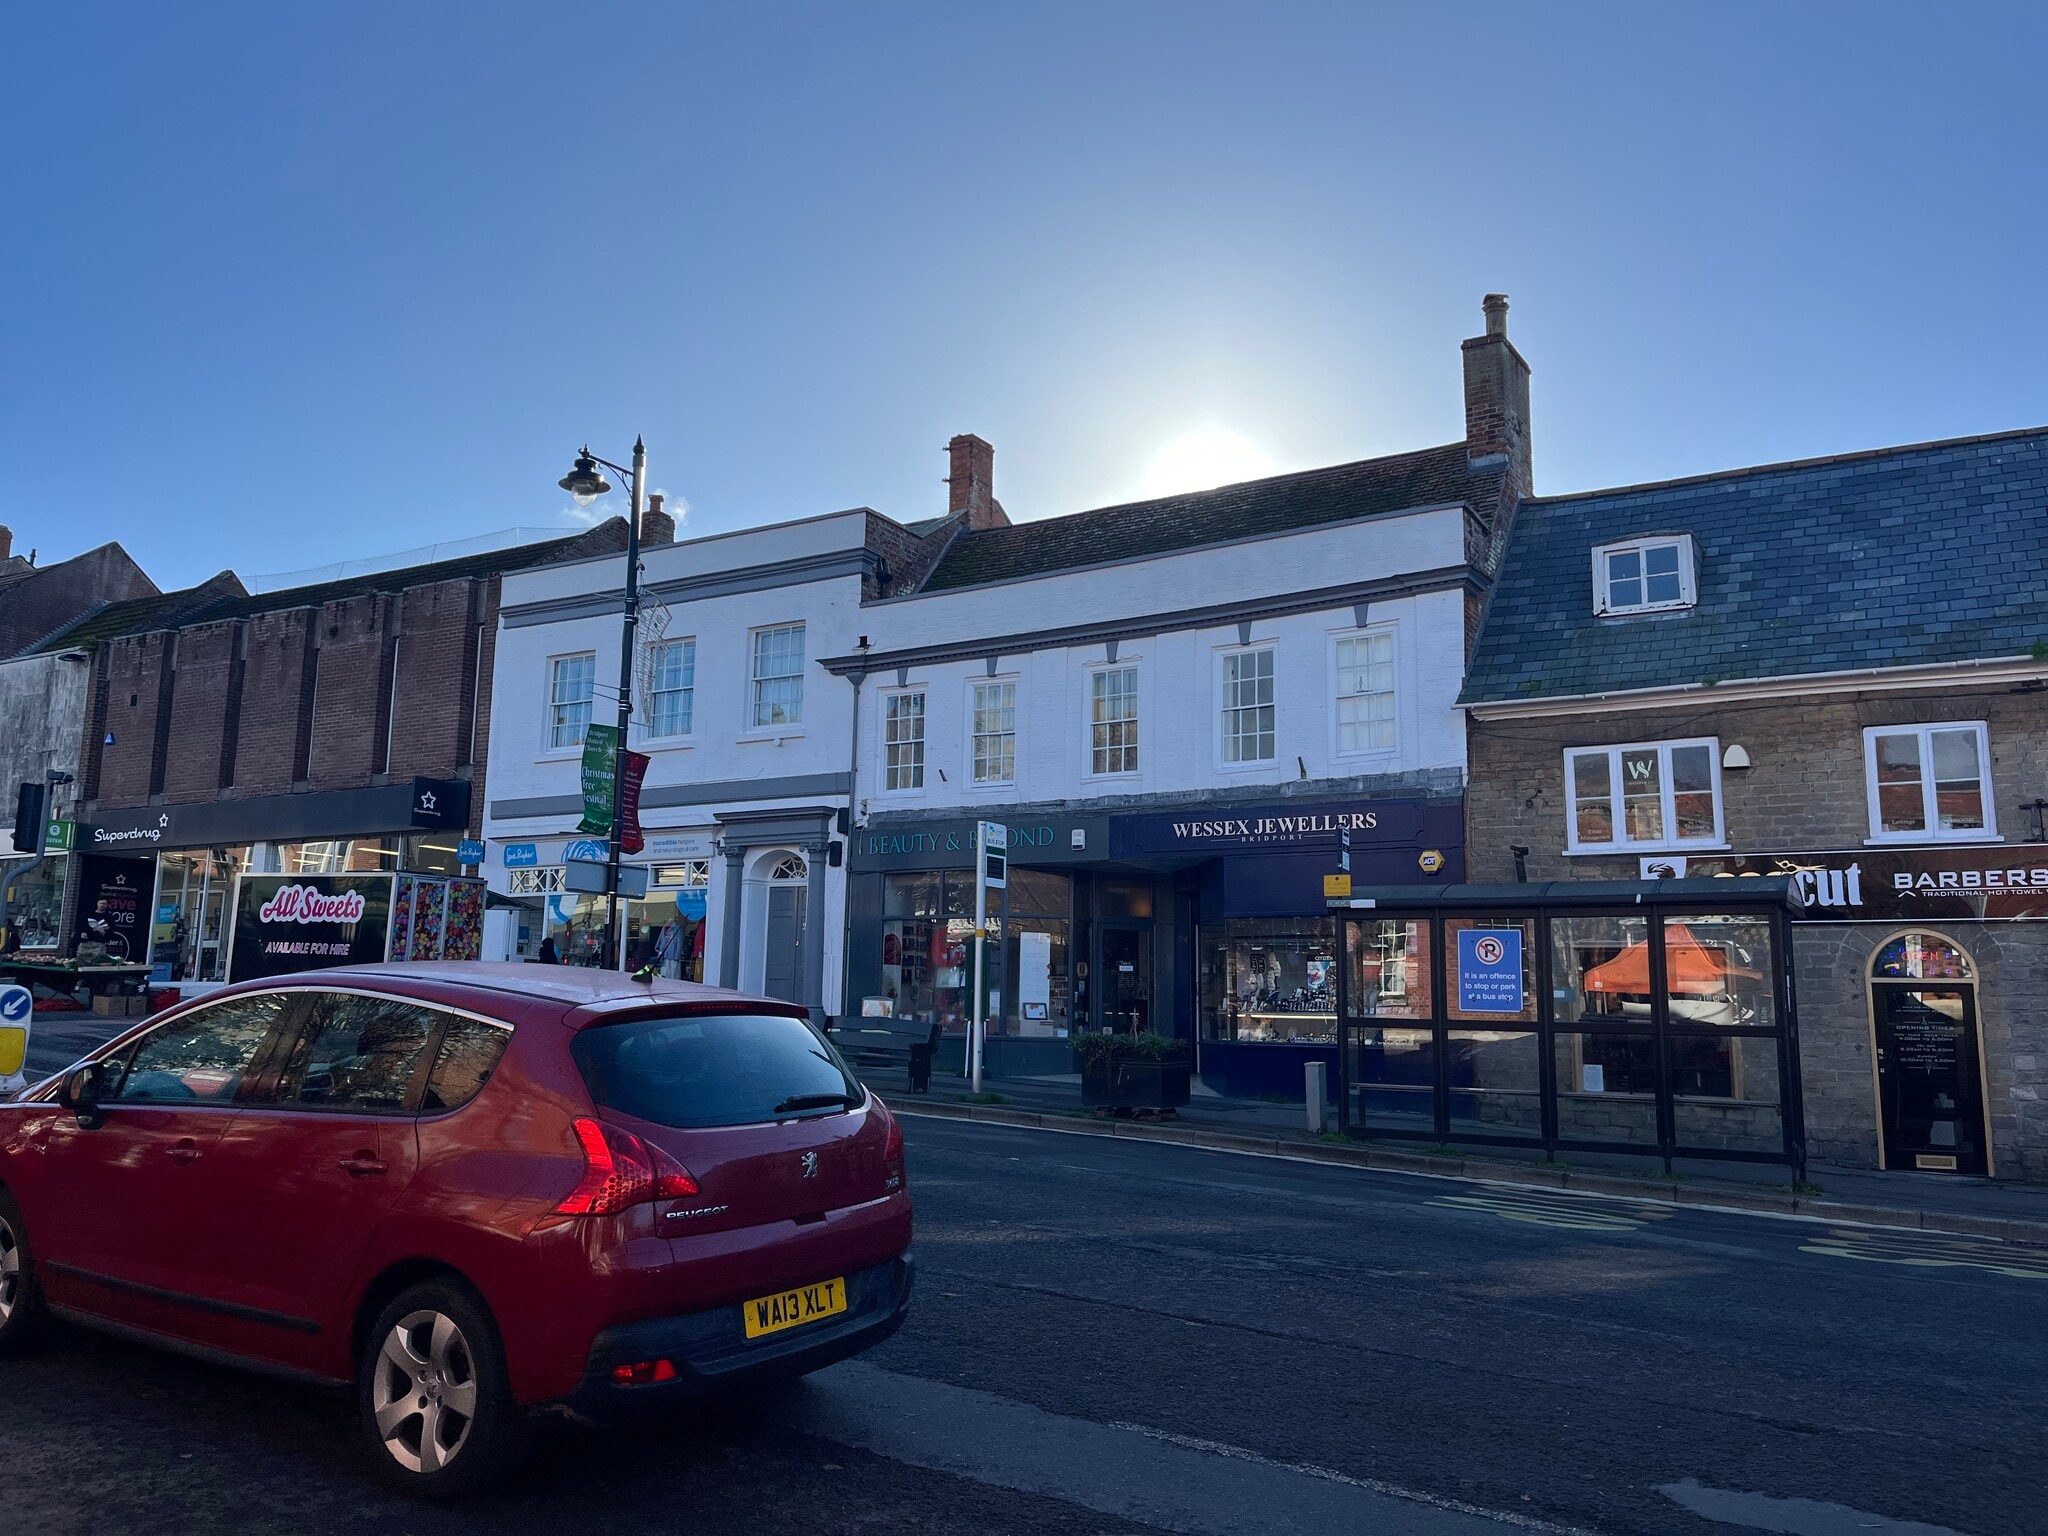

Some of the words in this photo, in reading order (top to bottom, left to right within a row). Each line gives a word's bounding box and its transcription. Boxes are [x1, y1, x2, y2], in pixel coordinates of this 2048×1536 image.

[582, 766, 615, 779] Christmas
[582, 779, 595, 790] Tree
[583, 791, 607, 804] Festival
[1173, 819, 1250, 838] WESSEX
[1254, 812, 1377, 835] JEWELLERS
[94, 827, 161, 843] Superdrug
[869, 833, 941, 855] BEAUTY
[946, 832, 960, 850] &
[969, 826, 1055, 849] BOND
[1241, 834, 1303, 842] BRIDPORT
[1894, 869, 2048, 889] BARBERS
[262, 888, 300, 920] All
[299, 889, 363, 921] Sweets
[265, 942, 310, 954] AVAILABLE
[310, 943, 329, 955] FOR
[329, 944, 350, 955] HIRE
[1901, 951, 1939, 960] OPEN
[1474, 983, 1489, 991] stop
[1500, 983, 1516, 991] park
[1498, 993, 1513, 1001] stop
[666, 1205, 729, 1219] PEUGEOT
[757, 1293, 800, 1328] WA13
[804, 1283, 834, 1316] XLT
